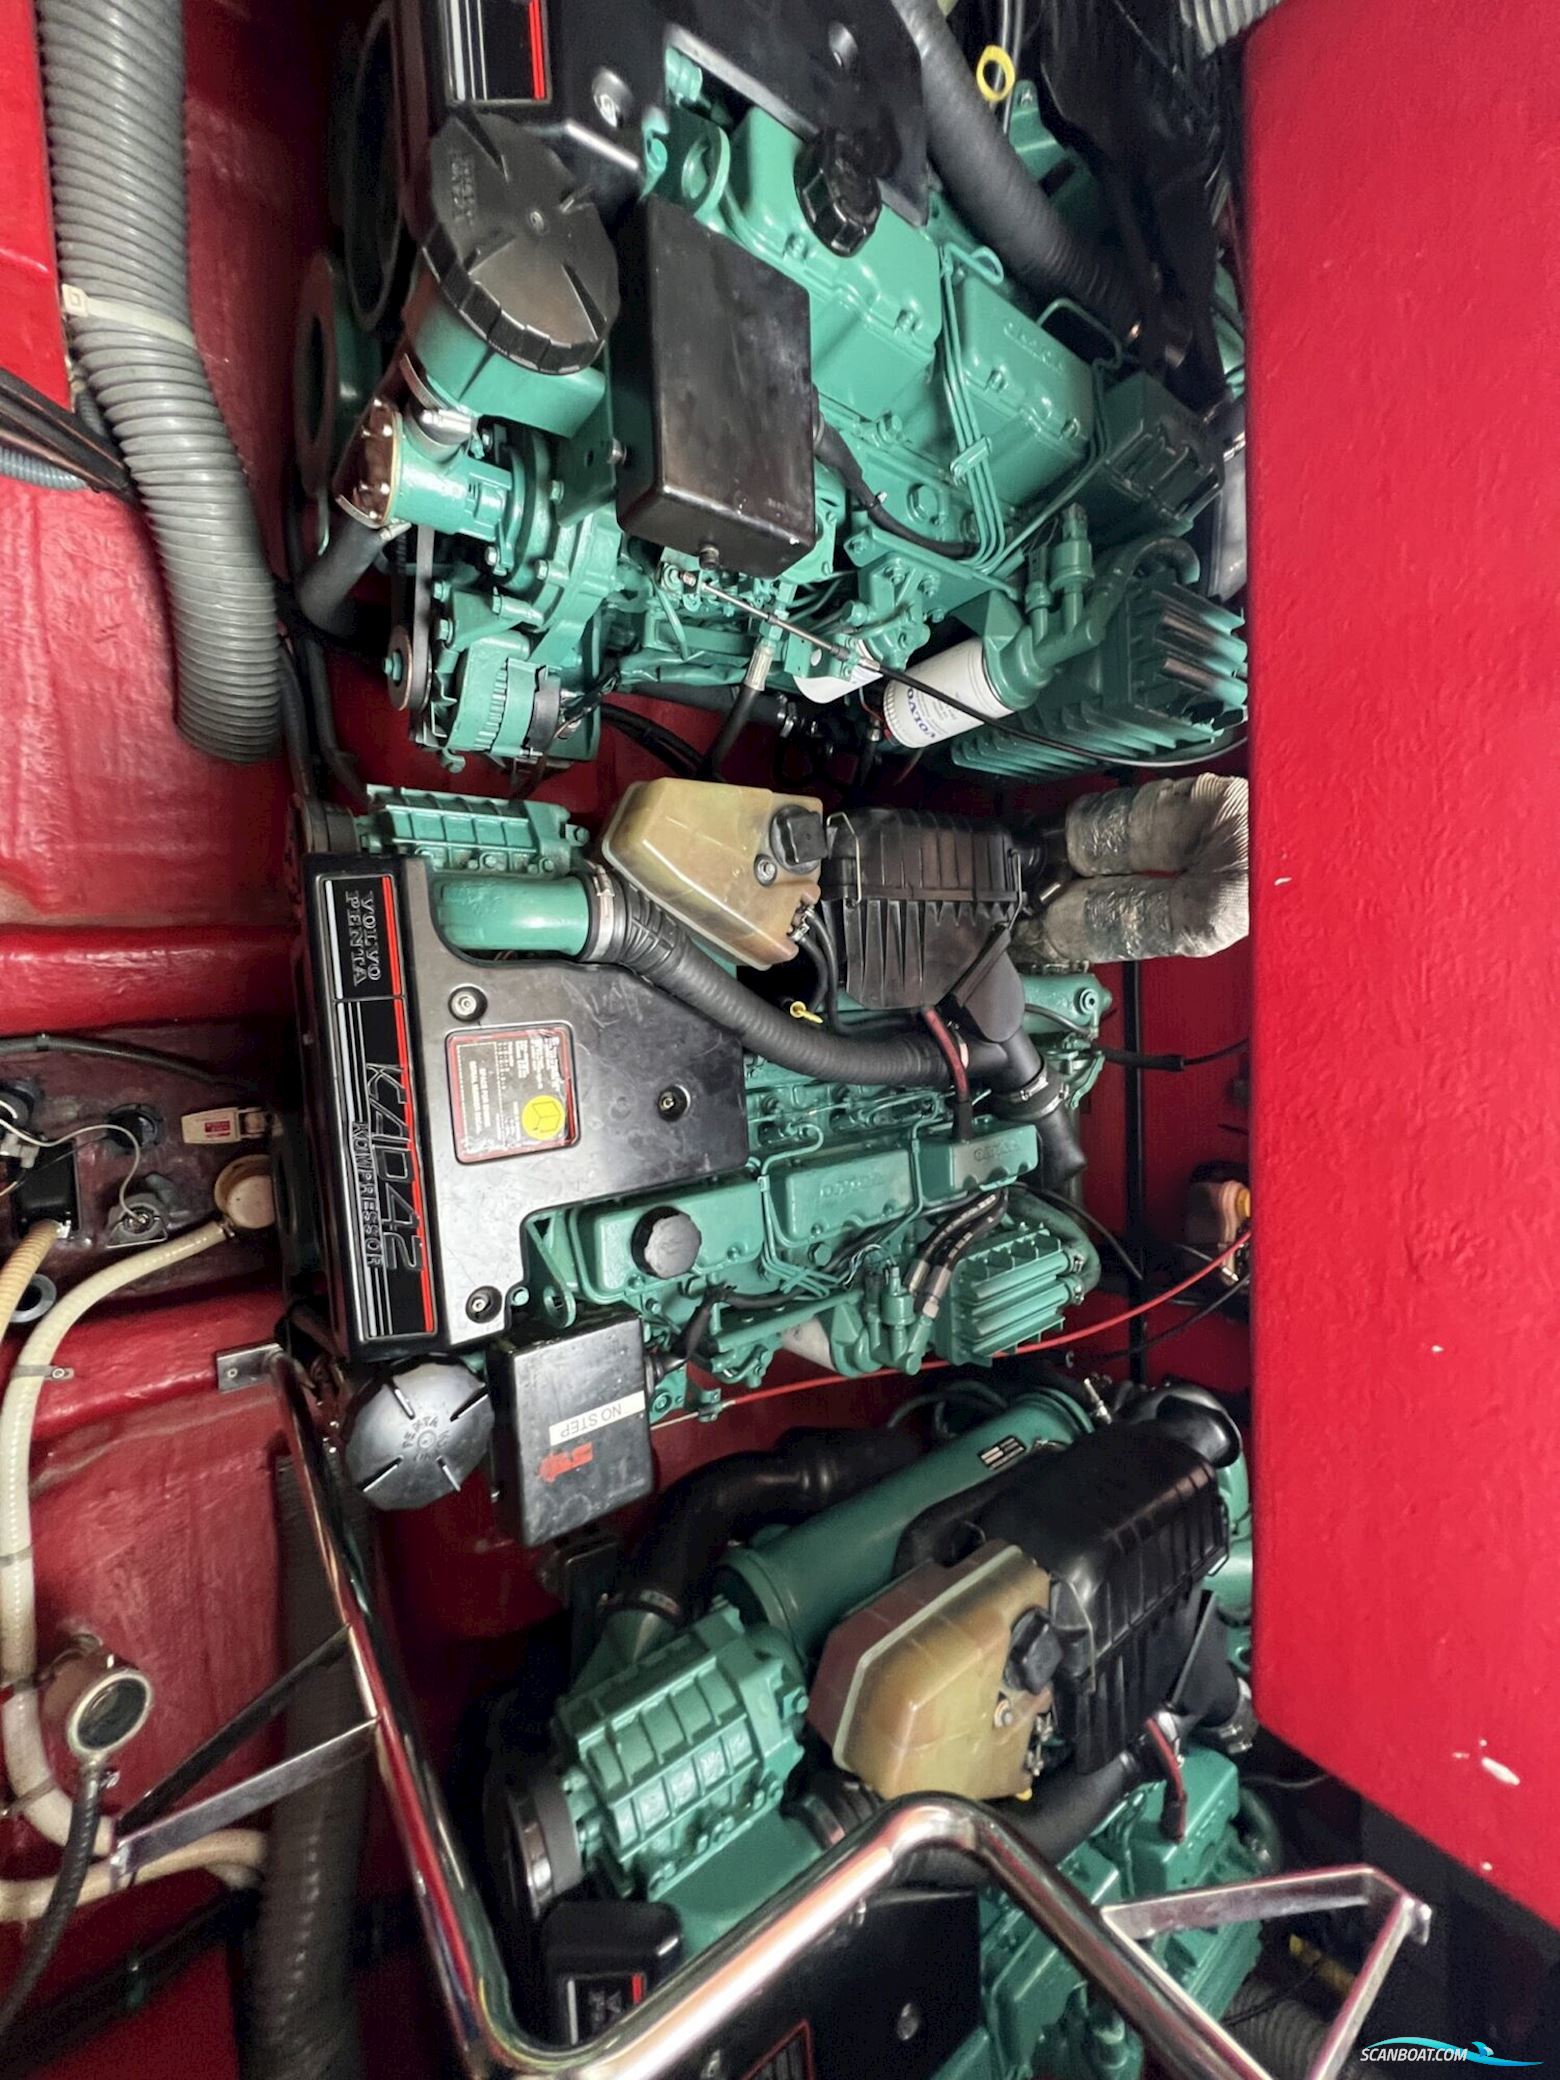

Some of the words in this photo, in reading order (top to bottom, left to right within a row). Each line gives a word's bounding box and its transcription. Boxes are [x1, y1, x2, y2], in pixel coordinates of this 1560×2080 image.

[907, 687, 935, 738] VOLVO
[345, 890, 367, 987] PENTA
[361, 890, 381, 981] VOLVO
[352, 1121, 384, 1268] KOMPRESSOR
[560, 1413, 598, 1438] STEP
[601, 1403, 622, 1422] NO
